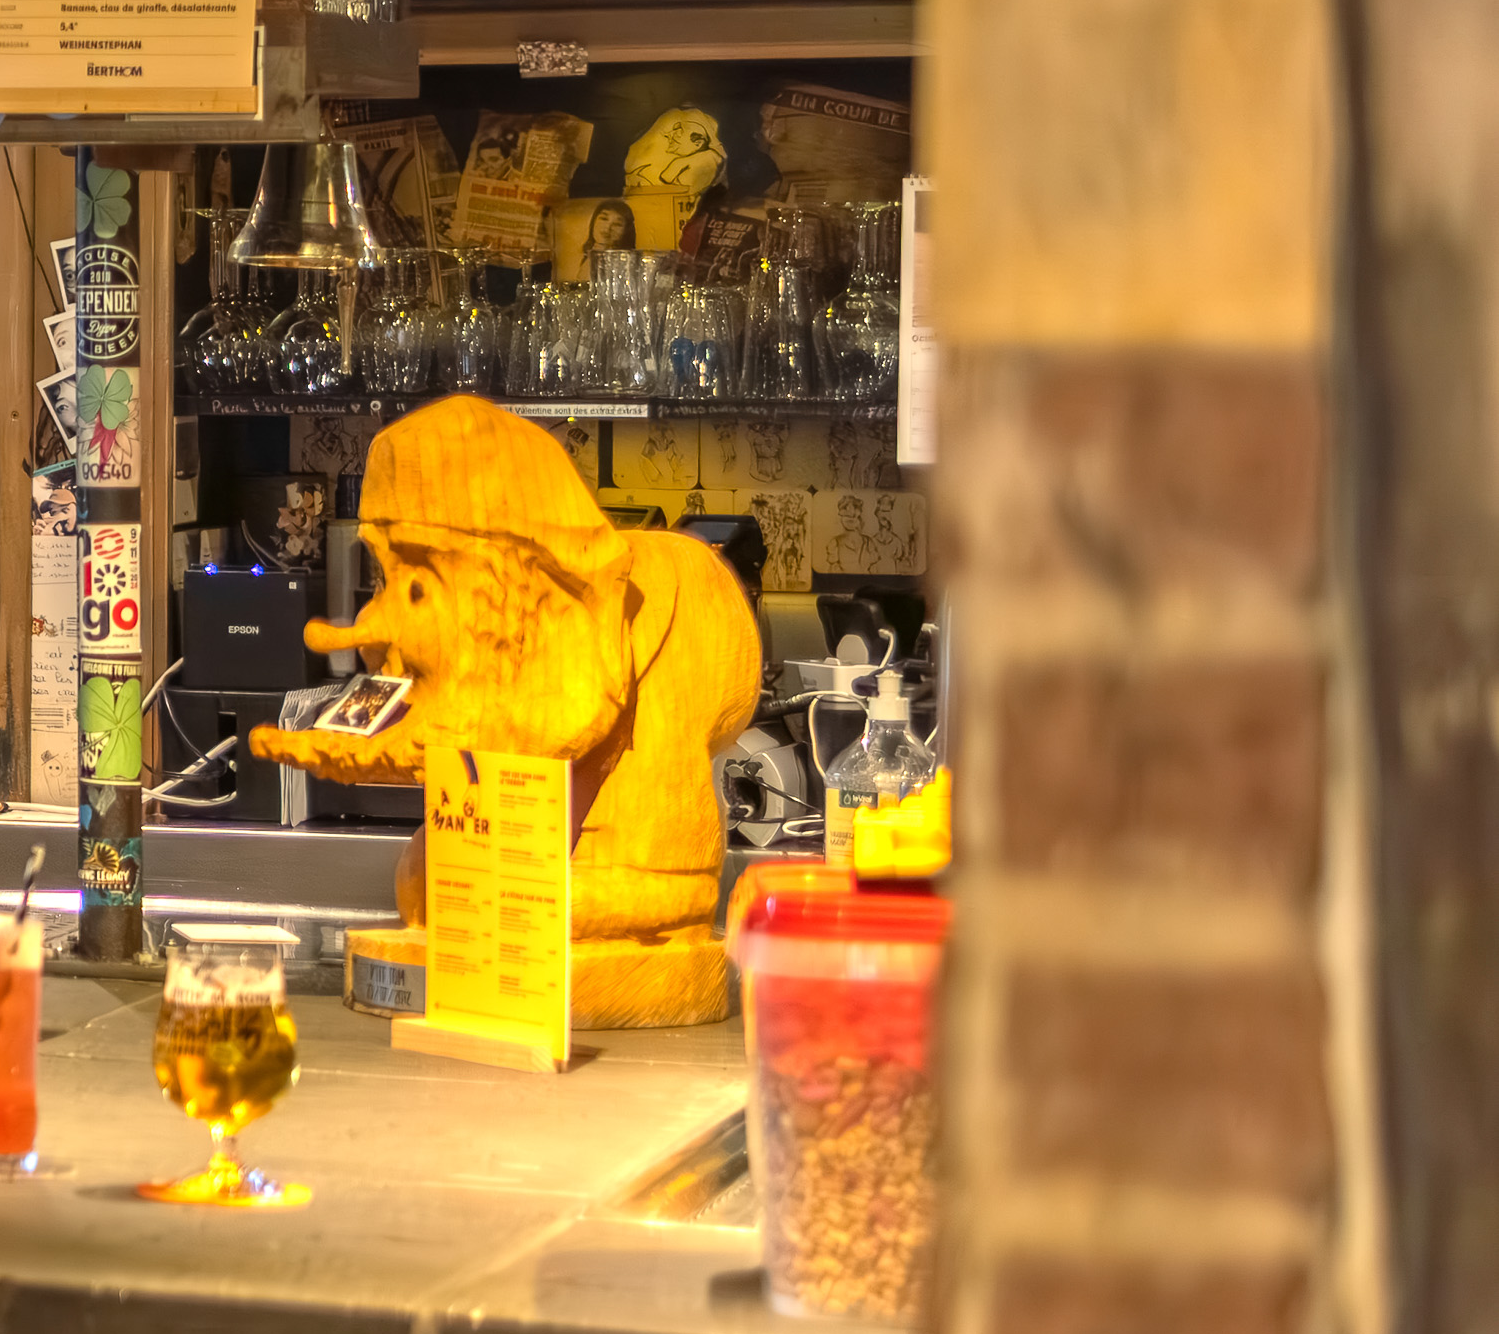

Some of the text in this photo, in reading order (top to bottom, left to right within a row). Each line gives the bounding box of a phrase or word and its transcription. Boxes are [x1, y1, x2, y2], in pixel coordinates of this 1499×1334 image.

[59, 40, 142, 50] WEIHENSTEPHAN
[554, 405, 572, 416] sont
[573, 405, 588, 416] des
[227, 624, 260, 635] EPSON
